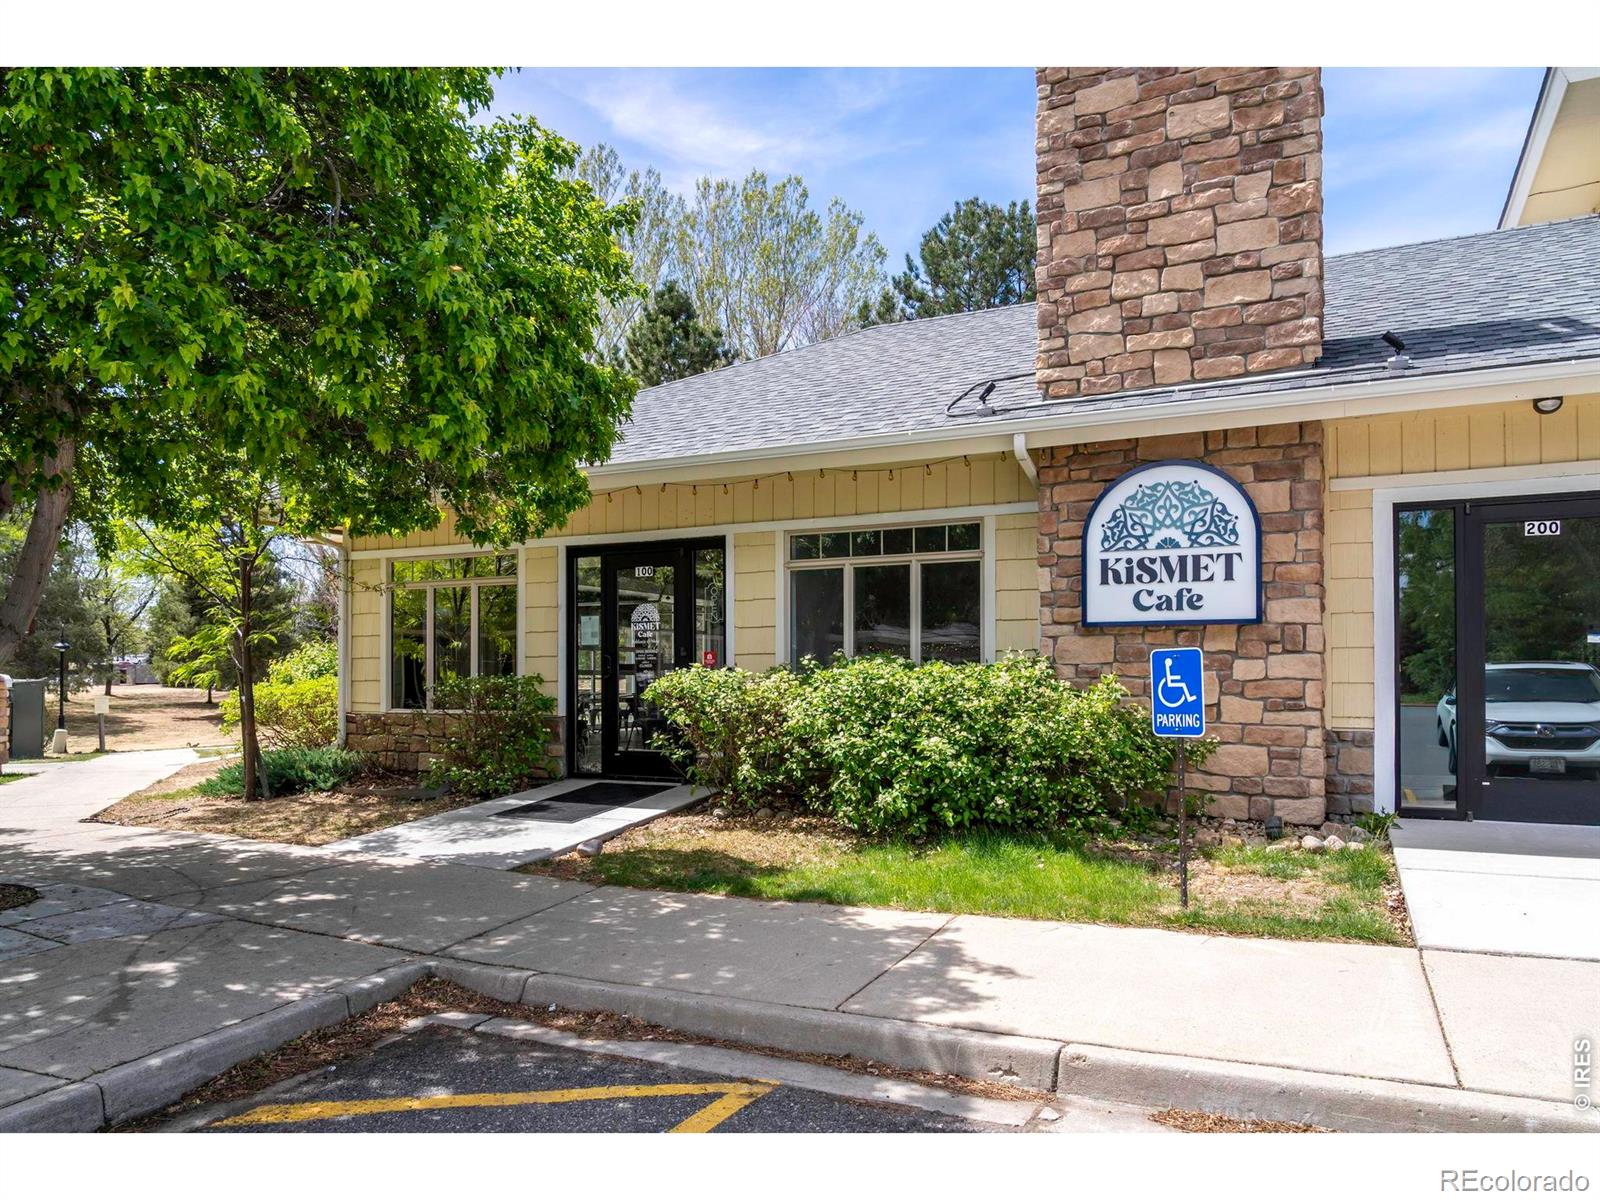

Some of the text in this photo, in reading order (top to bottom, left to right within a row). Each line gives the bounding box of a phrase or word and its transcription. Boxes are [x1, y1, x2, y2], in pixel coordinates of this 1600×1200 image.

[1526, 521, 1559, 535] 200
[637, 566, 653, 576] 100
[1132, 587, 1205, 612] Cafe
[1156, 713, 1200, 727] PARKING
